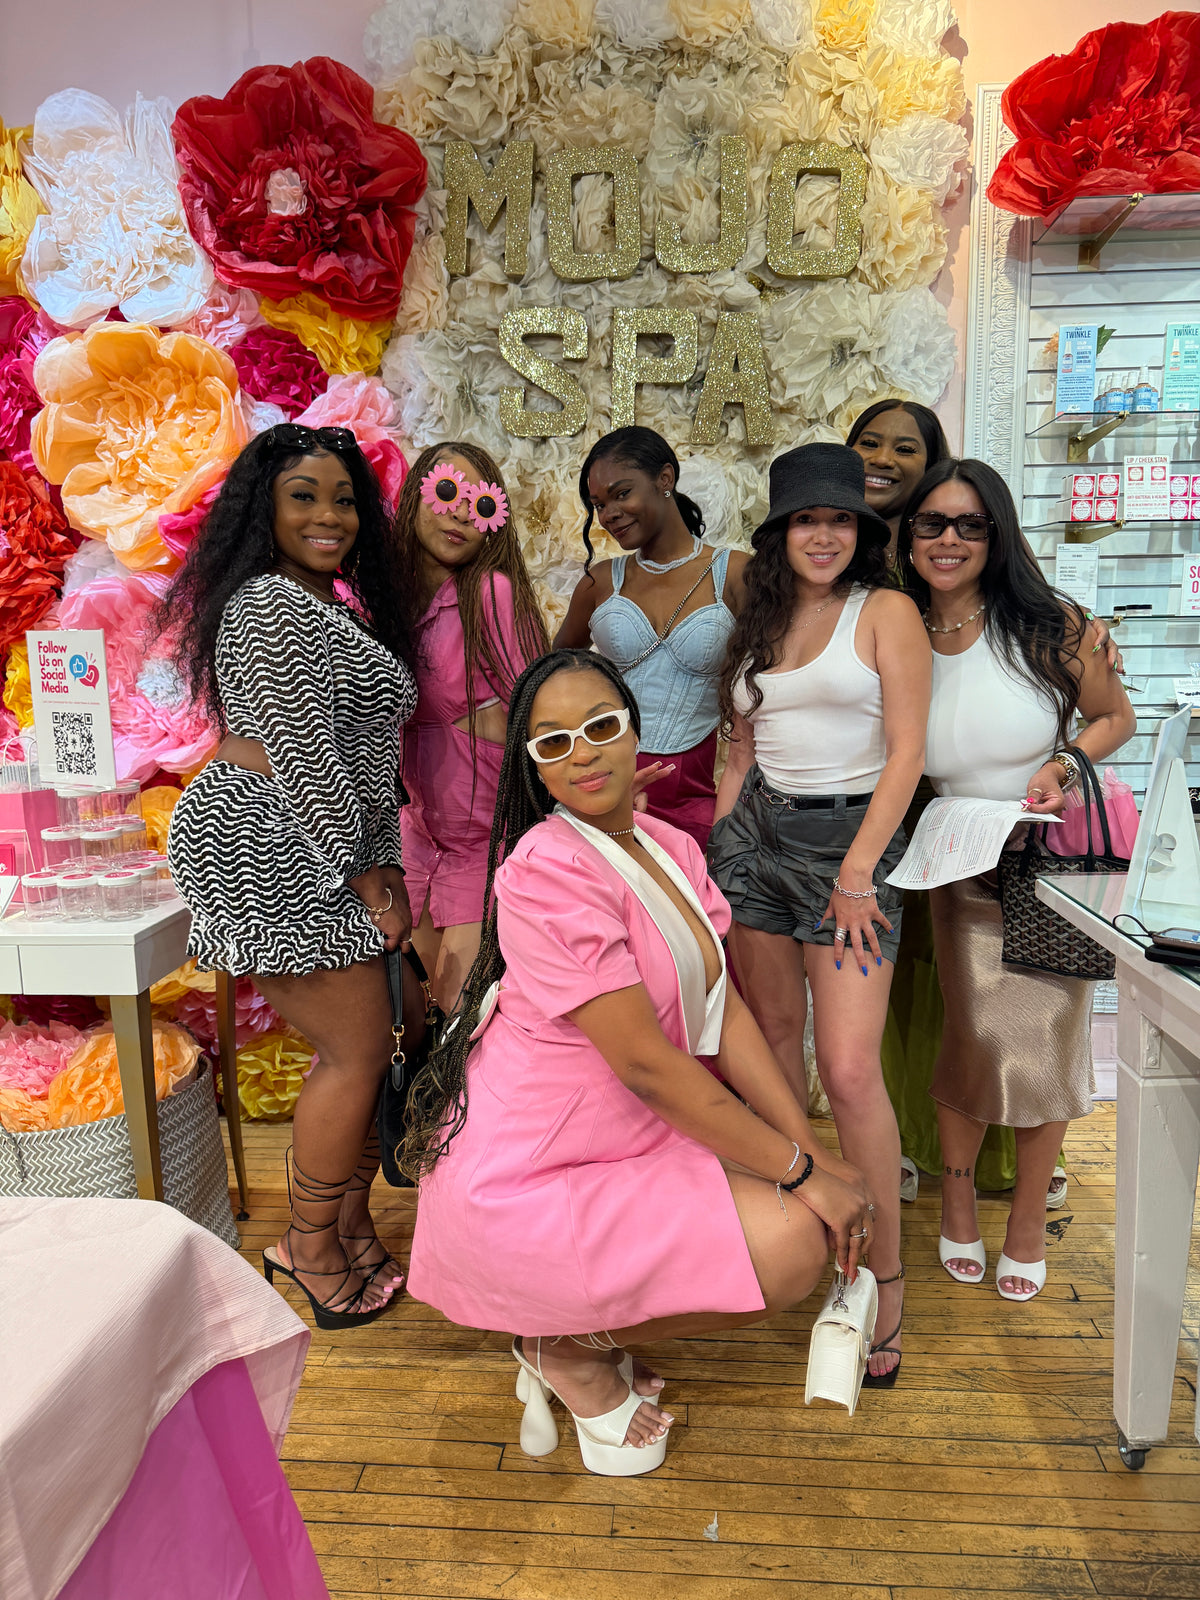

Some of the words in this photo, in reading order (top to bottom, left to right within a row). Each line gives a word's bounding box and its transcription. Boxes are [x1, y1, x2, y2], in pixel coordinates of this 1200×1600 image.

[443, 134, 867, 279] MOJO
[1065, 330, 1091, 339] TWINKLE
[1173, 328, 1199, 337] TWINKLE
[499, 305, 776, 447] SPA
[37, 640, 68, 654] Follow
[38, 654, 50, 667] Us
[51, 658, 63, 667] on
[40, 667, 67, 680] Social
[41, 681, 69, 694] Media
